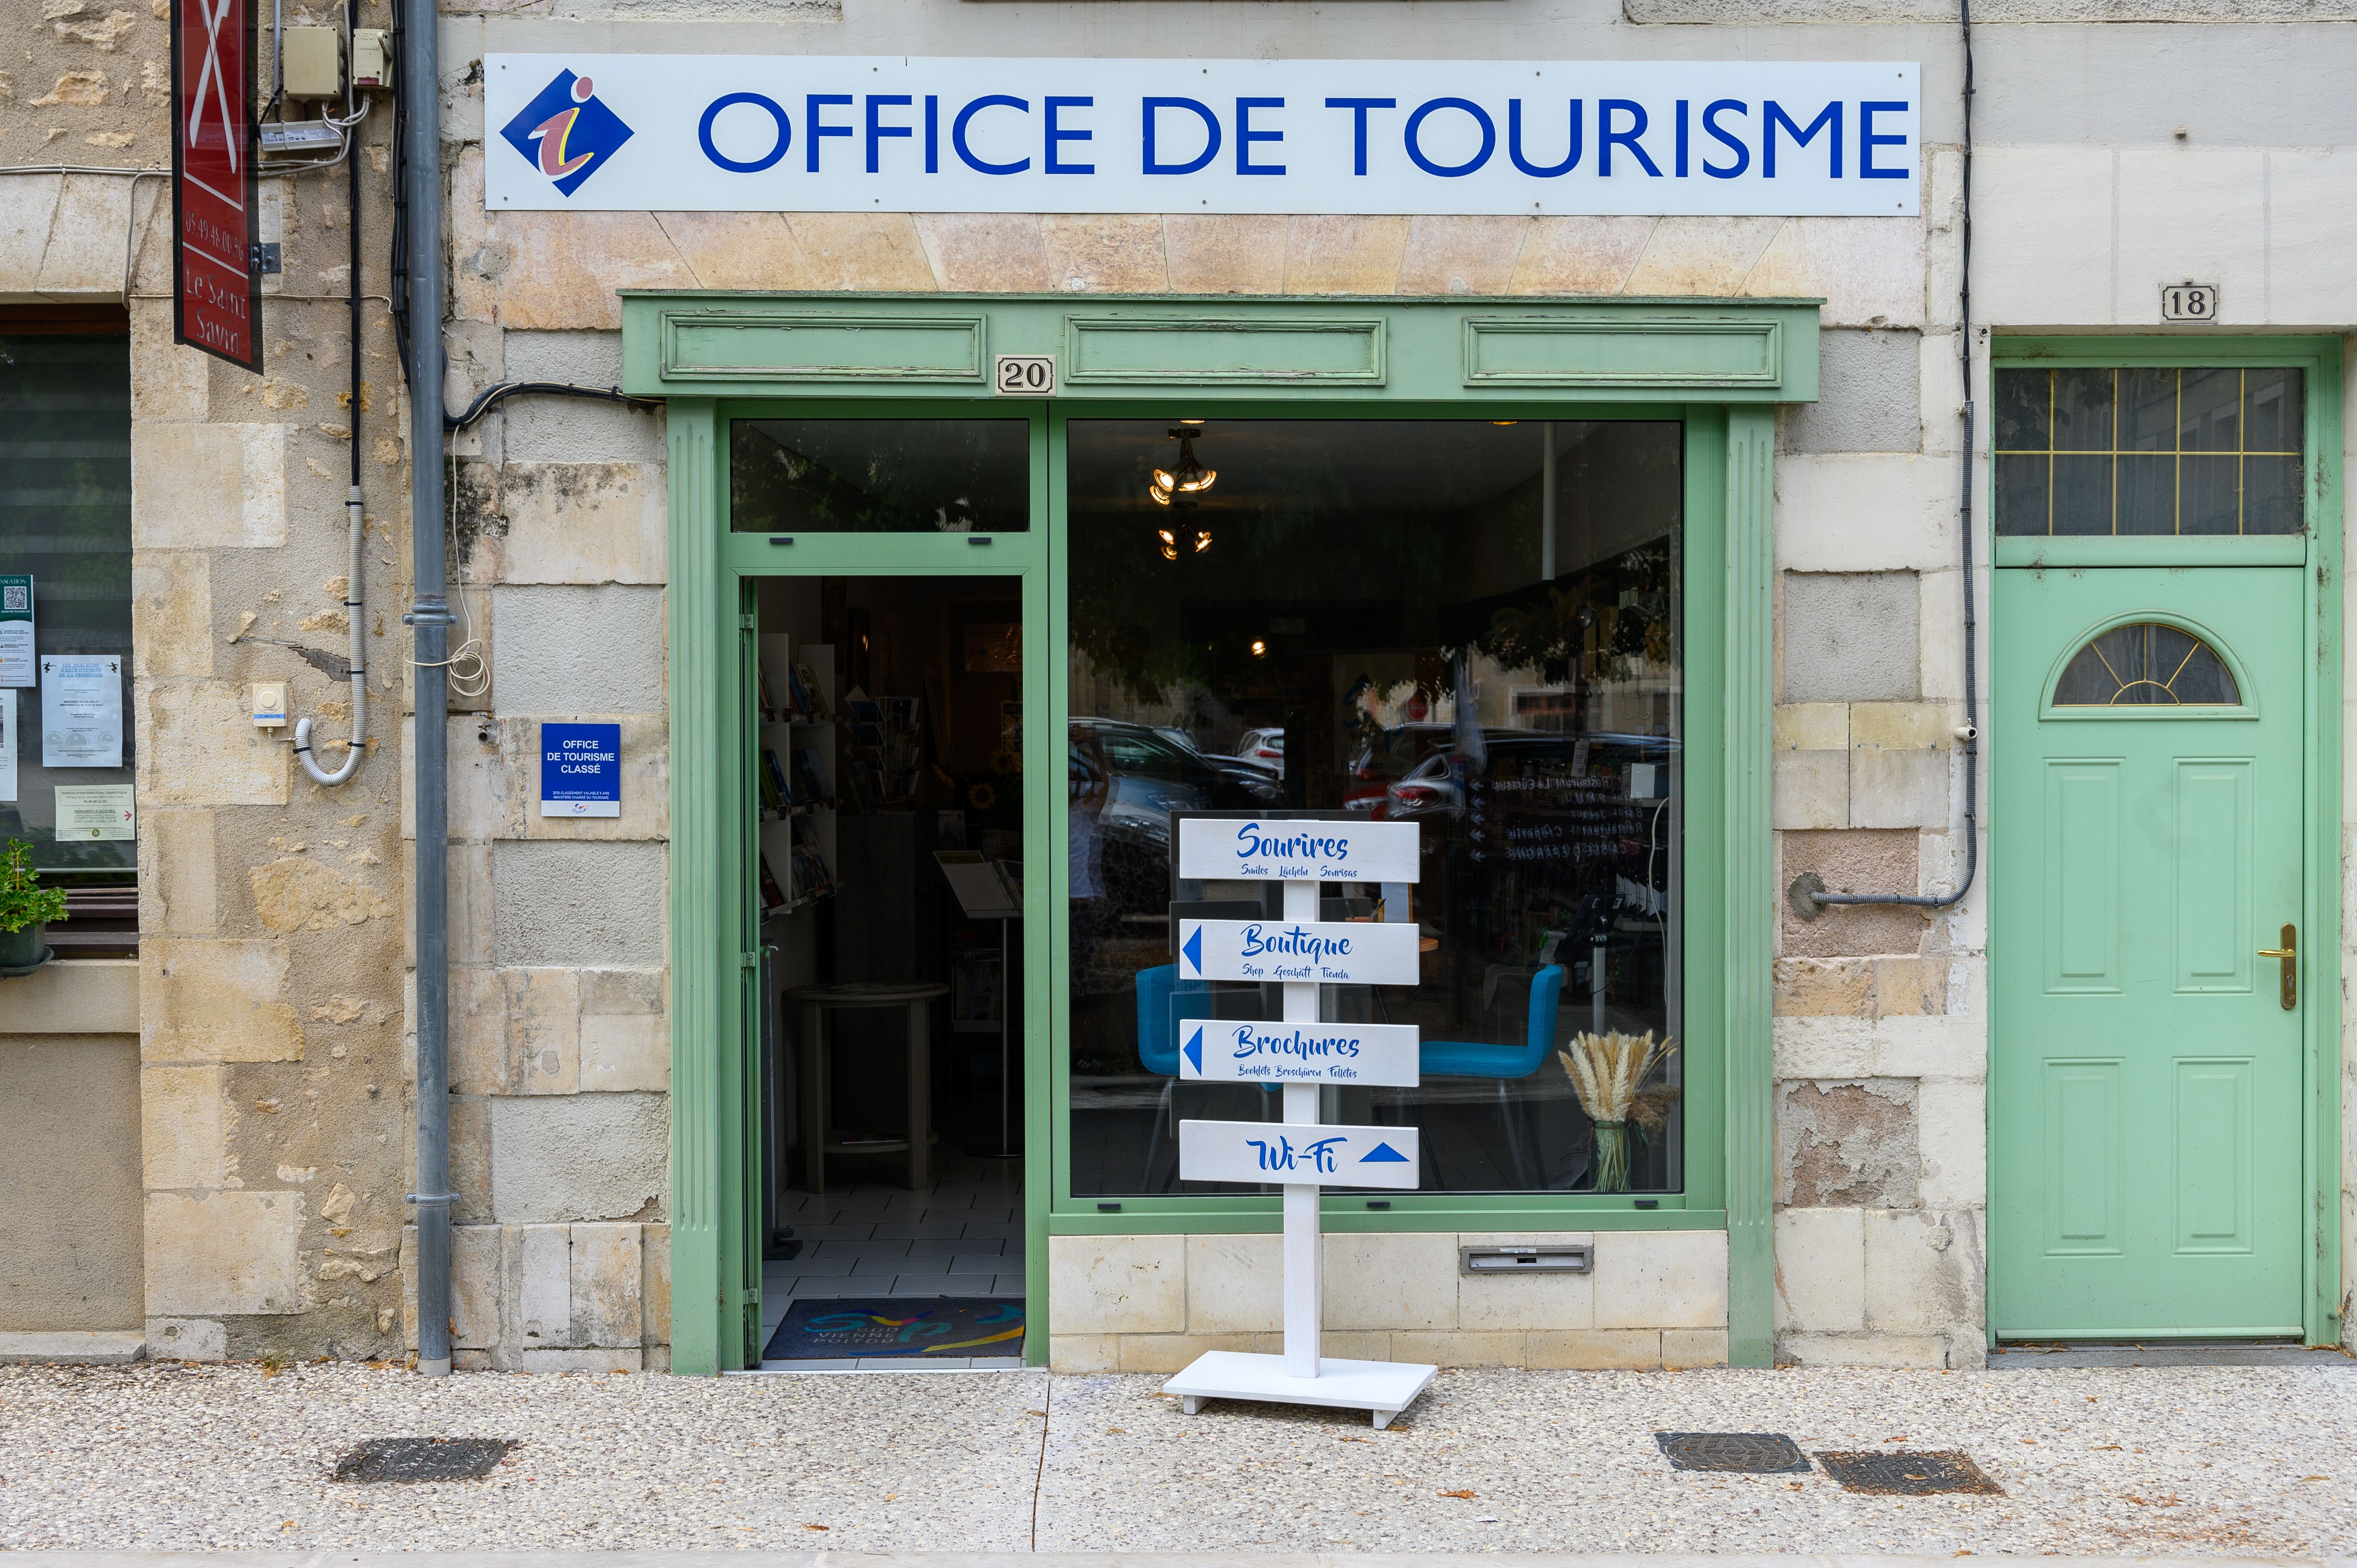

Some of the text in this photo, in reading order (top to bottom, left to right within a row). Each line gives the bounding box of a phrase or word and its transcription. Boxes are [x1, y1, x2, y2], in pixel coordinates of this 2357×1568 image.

[698, 92, 1909, 179] OFFICE DE TOURISME
[186, 210, 243, 261] 05.49.48.00.96
[186, 262, 246, 319] Le Saint
[2172, 291, 2206, 315] 18
[197, 308, 239, 355] Savin
[1005, 363, 1046, 387] 20
[547, 752, 615, 761] DE TOURISME
[563, 740, 599, 749] OFFICE
[561, 763, 601, 773] CLASSÉ
[1237, 823, 1348, 860] Sourires
[1241, 863, 1357, 878] Smiles Lächeln Sonrisas
[1240, 924, 1353, 965] Boutique
[1242, 963, 1350, 980] Shop Geschäft Tienda
[1232, 1025, 1360, 1060] Brochures
[1237, 1064, 1357, 1078] Booklets Broschüren Folletos
[1246, 1135, 1348, 1173] Wi-Fi
